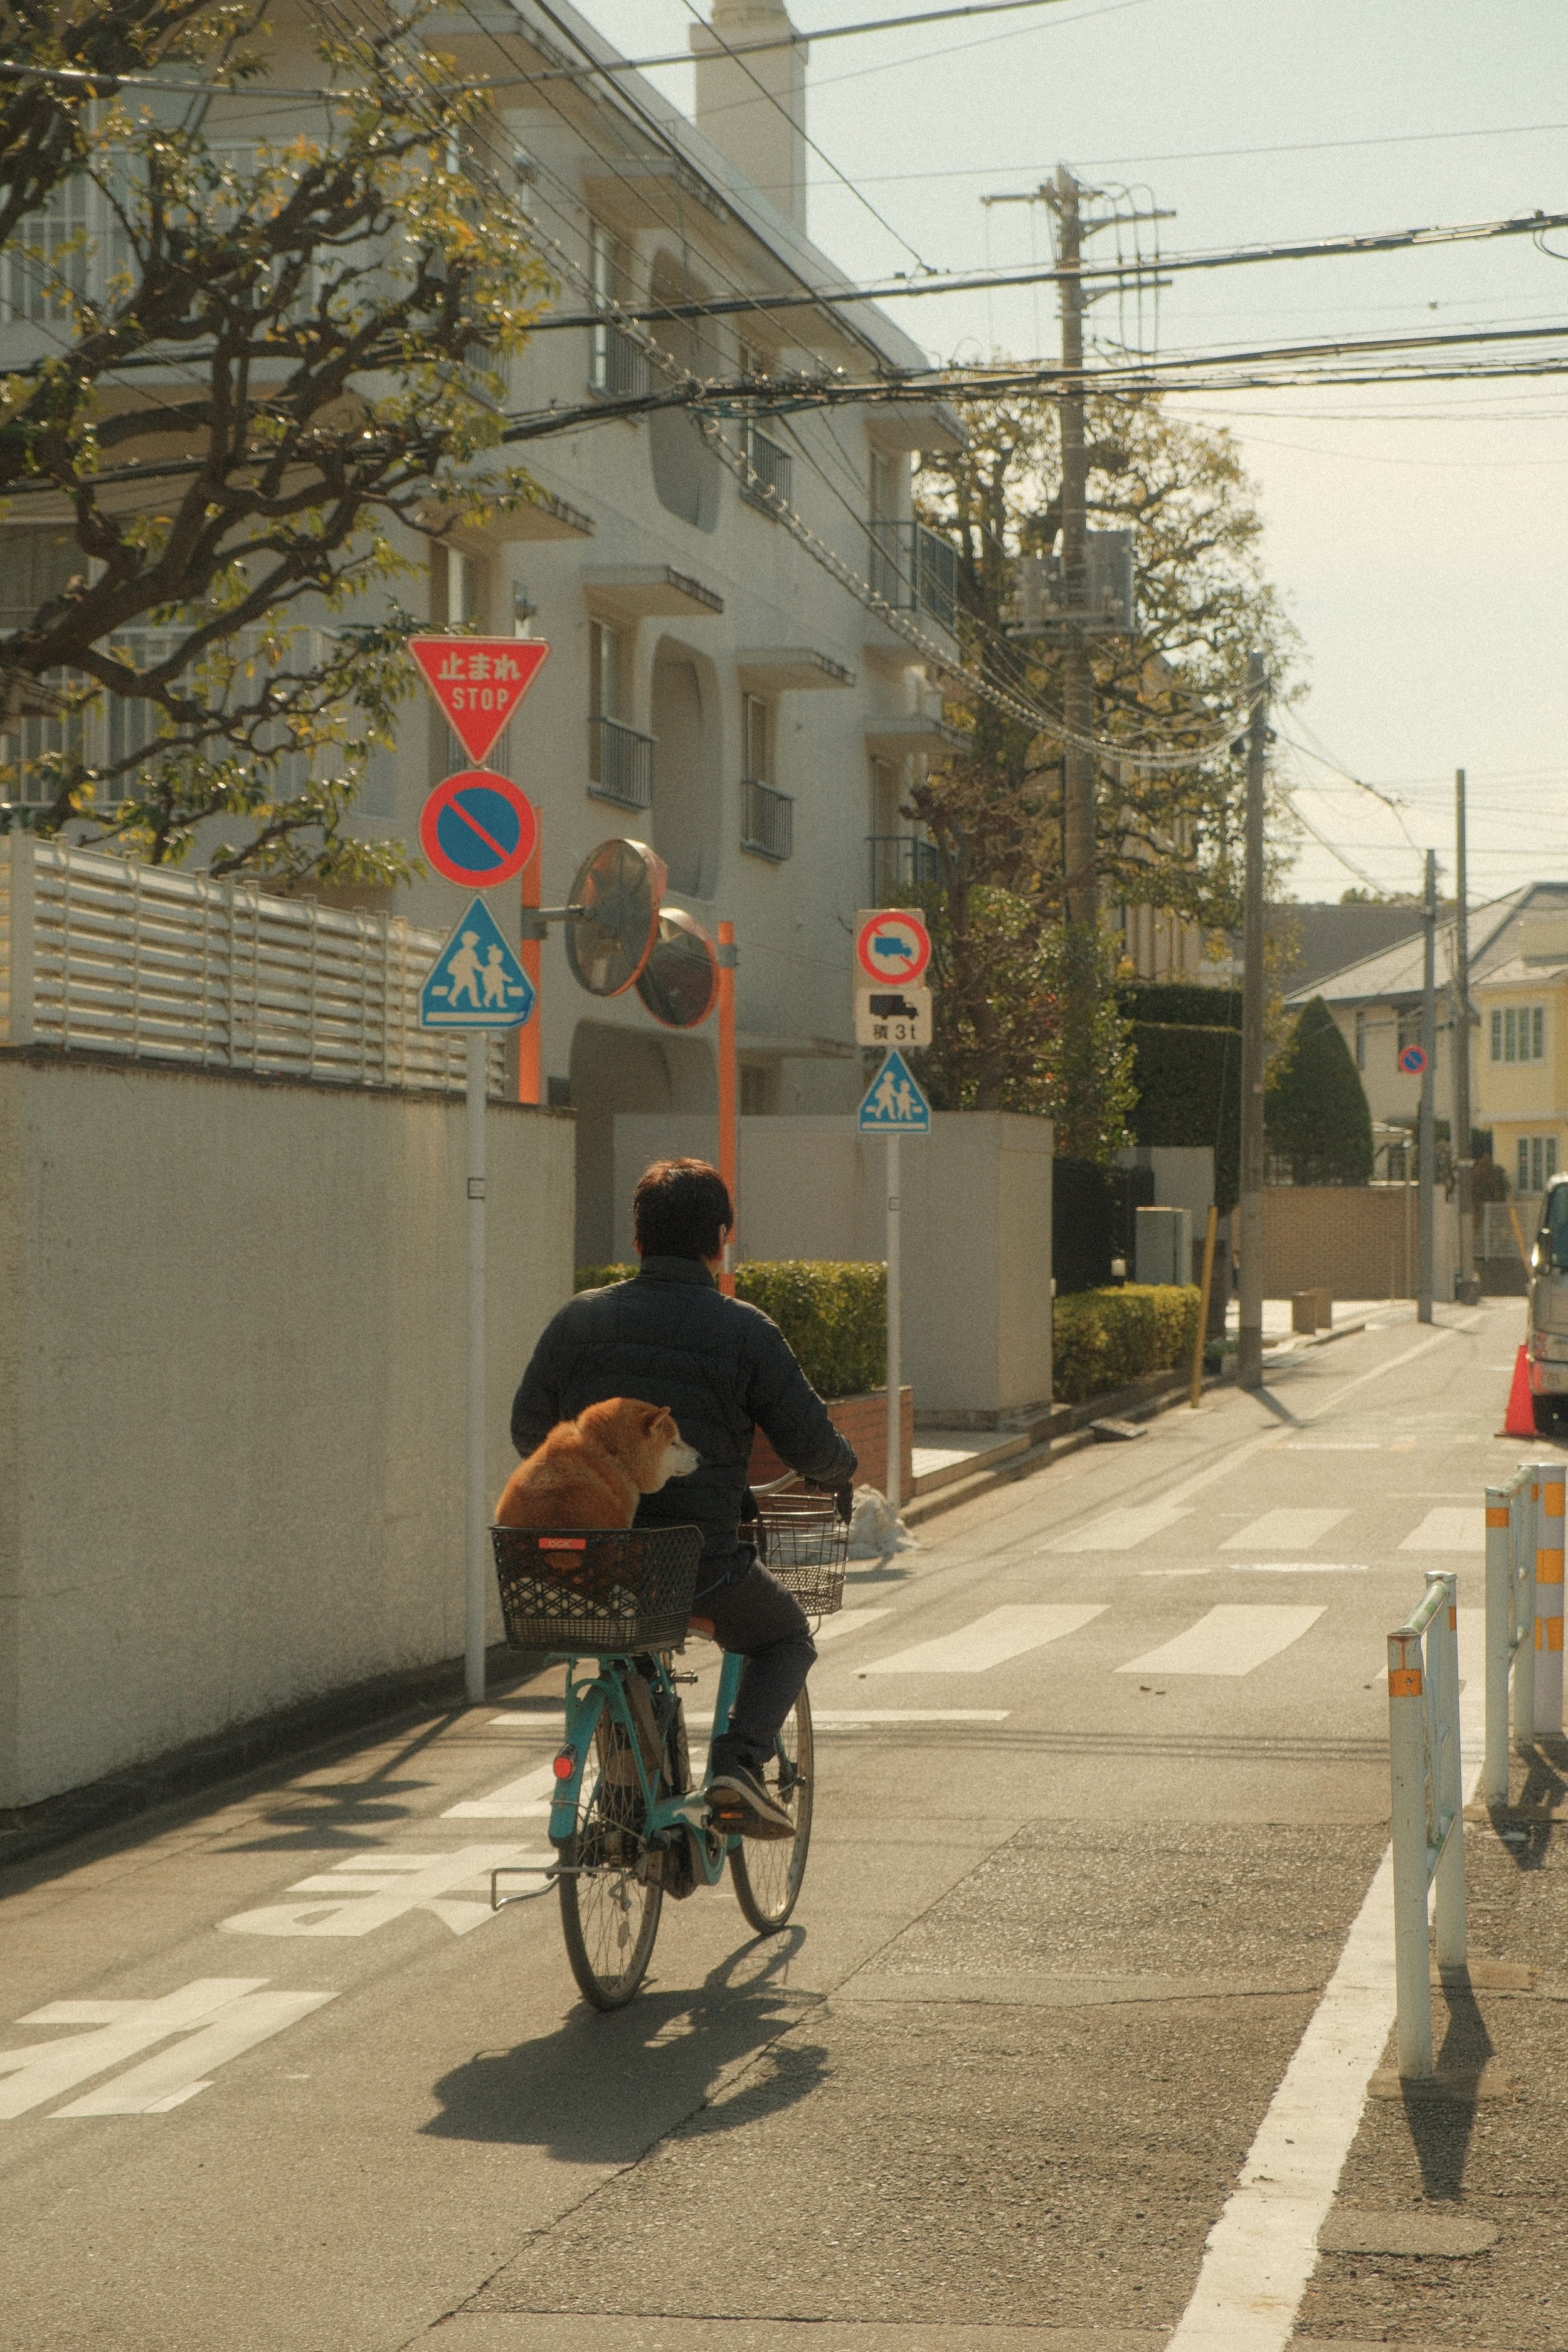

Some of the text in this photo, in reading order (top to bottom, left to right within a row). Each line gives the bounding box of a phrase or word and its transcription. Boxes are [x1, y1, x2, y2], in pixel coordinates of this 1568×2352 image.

[438, 651, 522, 681] 止まれ
[452, 687, 509, 711] STOP
